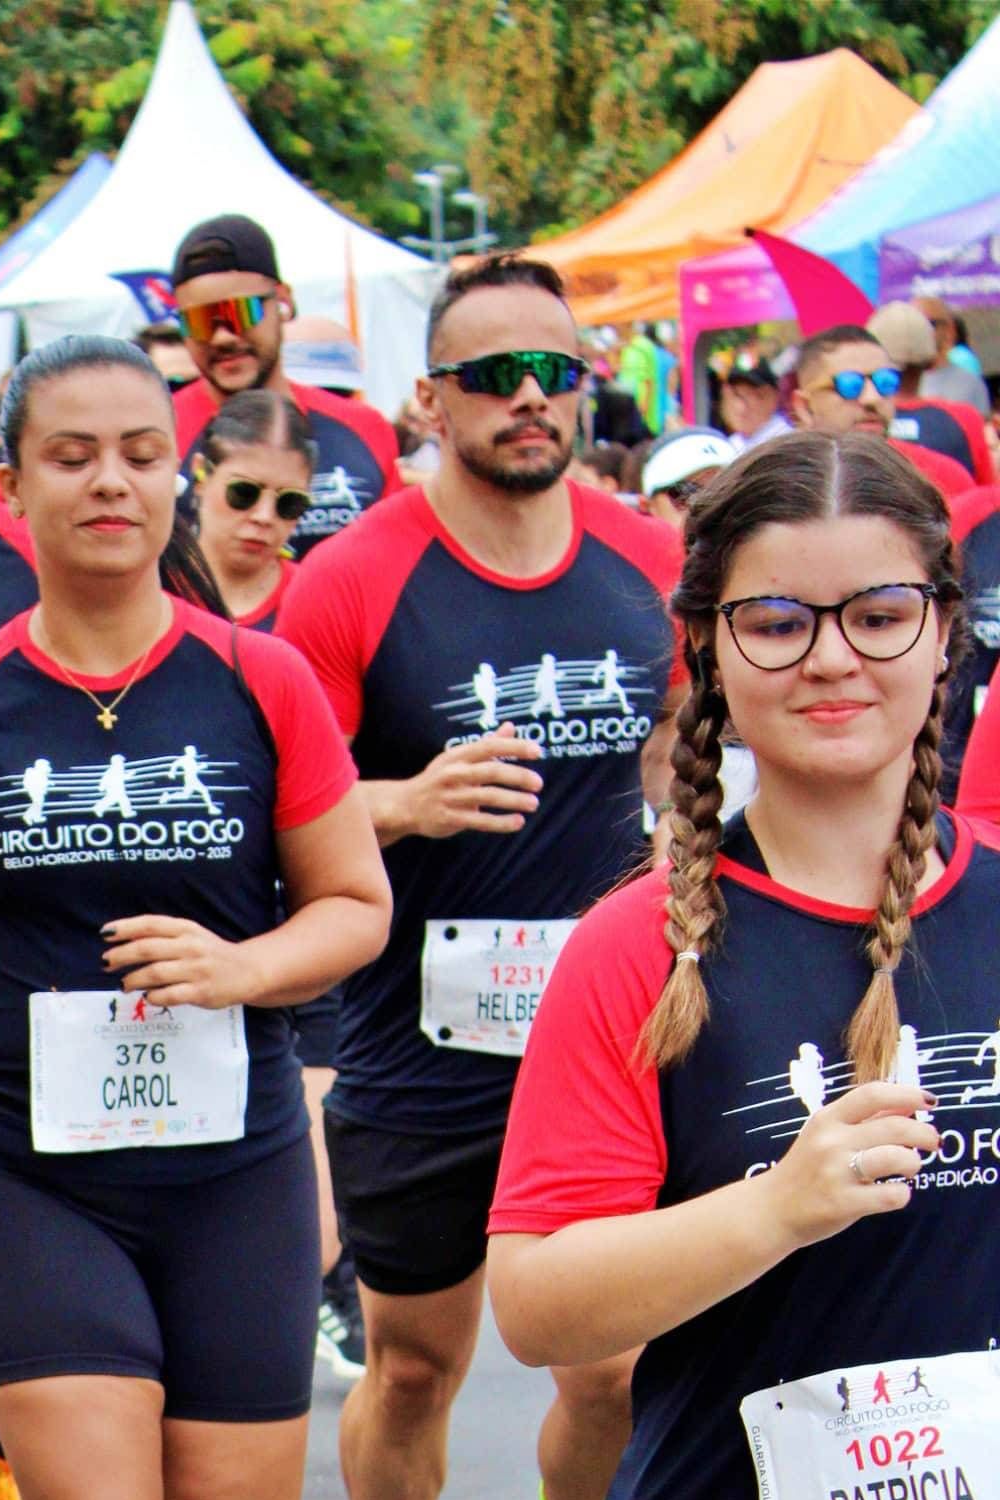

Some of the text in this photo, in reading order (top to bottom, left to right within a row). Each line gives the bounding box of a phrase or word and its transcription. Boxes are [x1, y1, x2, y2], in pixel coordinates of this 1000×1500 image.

[550, 720, 587, 744] DO
[591, 716, 650, 740] FOGO
[118, 821, 167, 846] DO
[173, 818, 244, 844] FOGO
[3, 857, 34, 870] BELO
[144, 846, 196, 861] EDIÇÃO
[490, 963, 546, 985] 1231
[476, 992, 541, 1022] HELBE
[115, 1043, 166, 1066] 376
[102, 1073, 177, 1110] CAROL
[936, 1166, 999, 1188] EDIÇÃO
[825, 1408, 883, 1431] CIRCUITO
[886, 1404, 908, 1419] DO
[910, 1399, 950, 1414] FOGO
[845, 1426, 945, 1471] 1022
